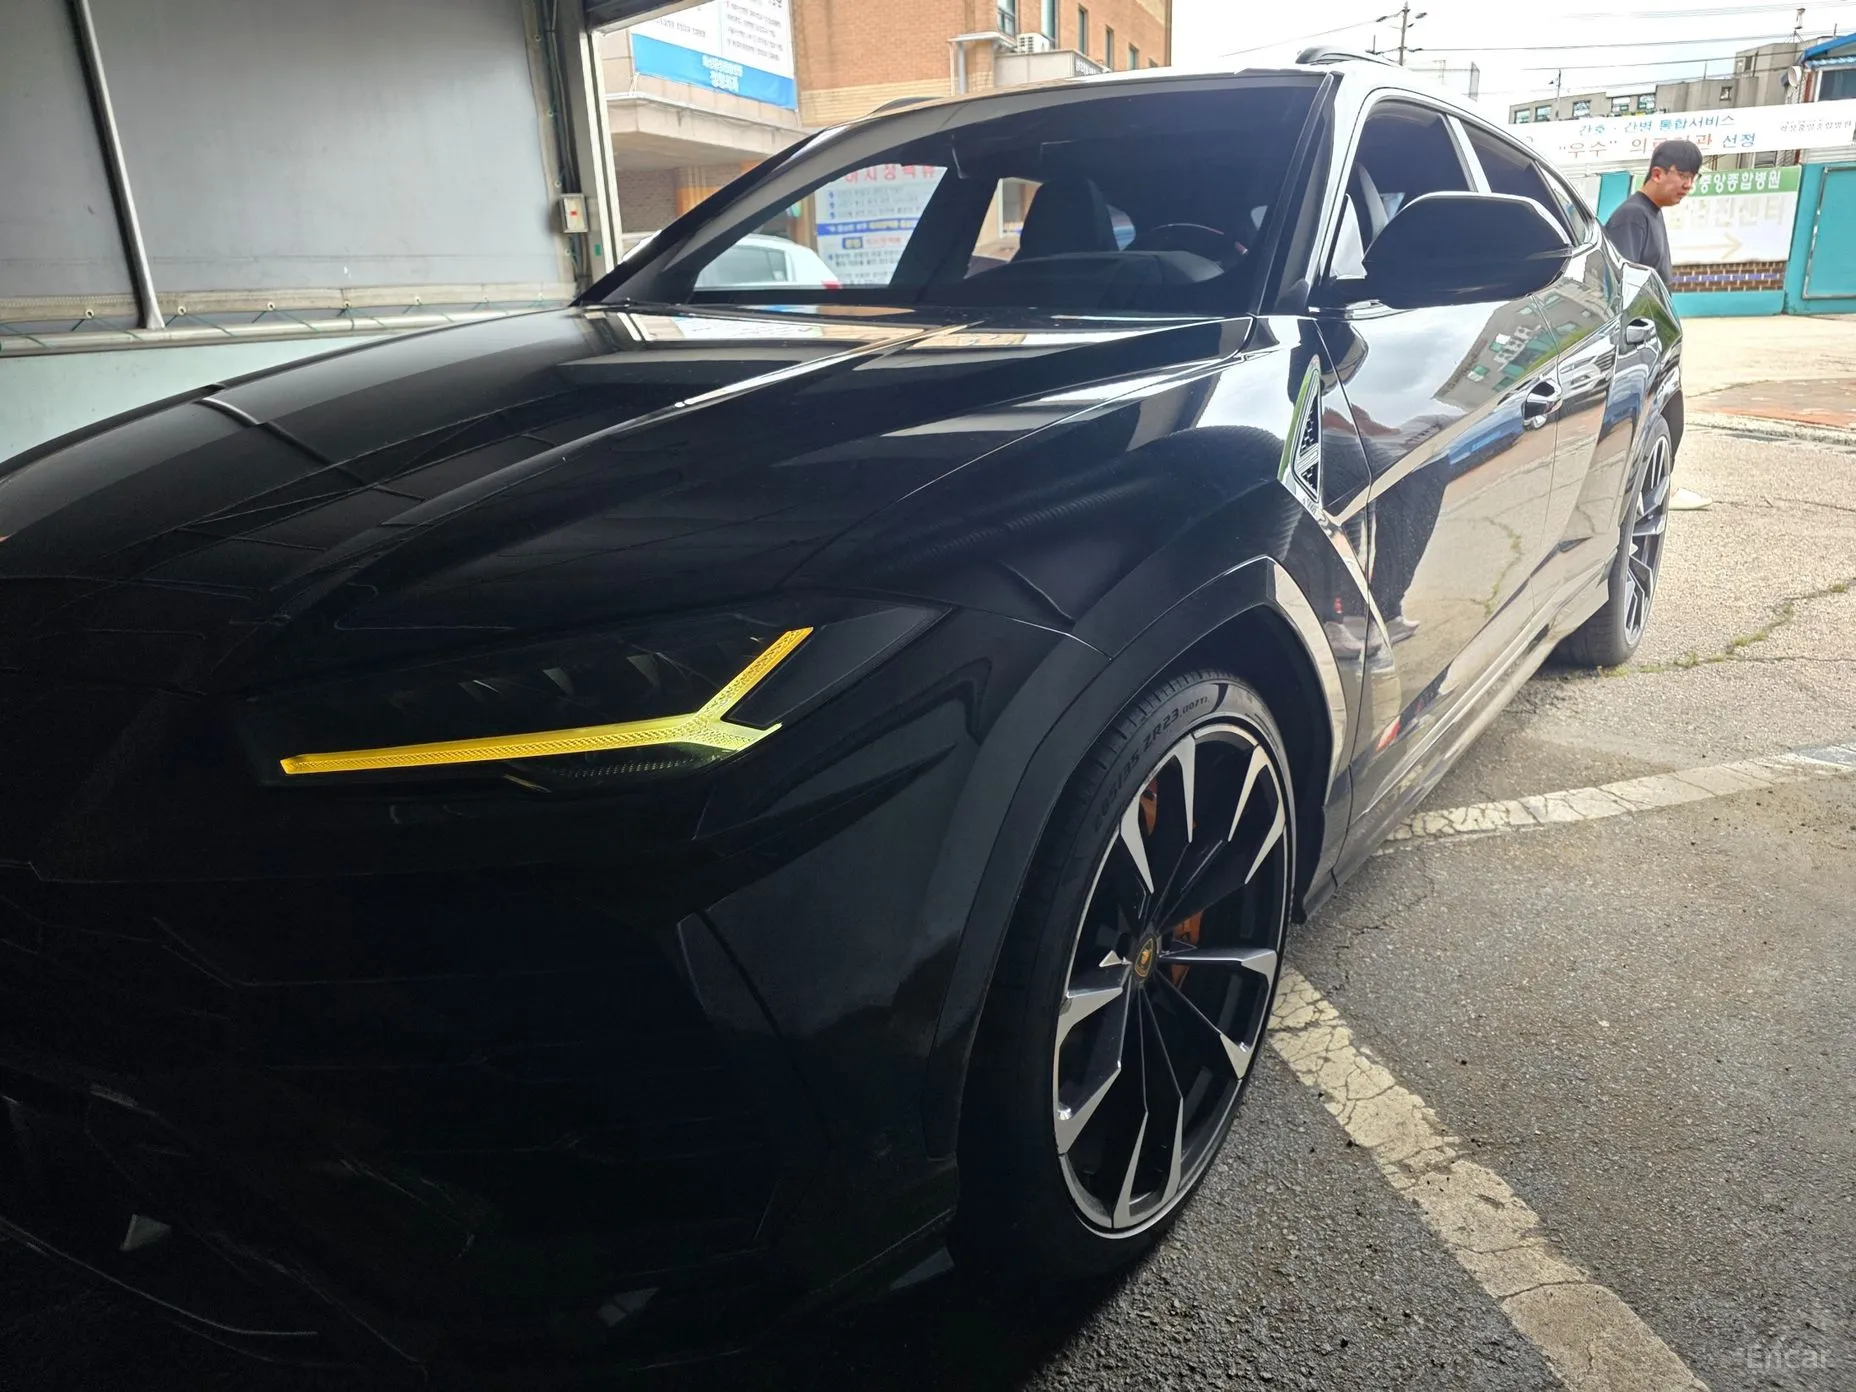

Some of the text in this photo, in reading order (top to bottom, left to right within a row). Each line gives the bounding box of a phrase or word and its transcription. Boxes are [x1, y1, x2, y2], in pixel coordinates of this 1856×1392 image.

[1624, 121, 1652, 133] 간병
[1659, 115, 1736, 130] 통합서비스
[1630, 133, 1713, 154] 의관
[1722, 132, 1757, 149] 선정
[1143, 708, 1180, 751] ZR23
